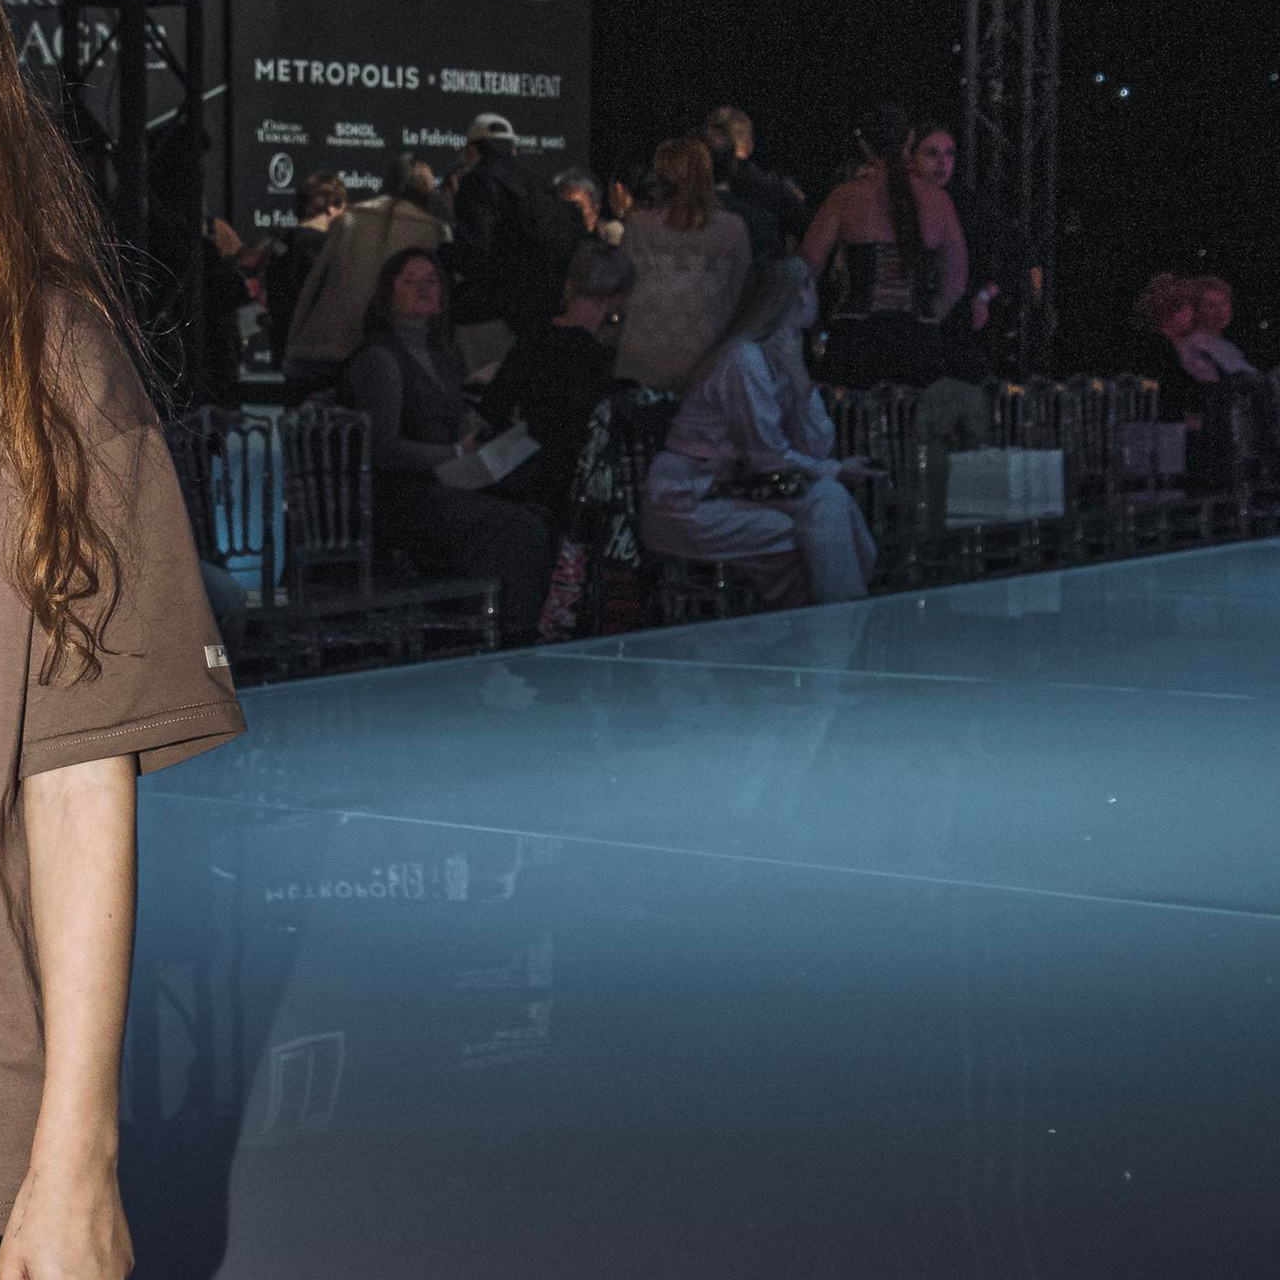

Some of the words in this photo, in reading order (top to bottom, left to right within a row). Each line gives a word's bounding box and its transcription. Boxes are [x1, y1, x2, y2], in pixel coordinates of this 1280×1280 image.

[254, 58, 419, 90] METROPOLIS
[402, 127, 418, 145] La
[420, 129, 467, 148] Fabriqu
[255, 210, 271, 227] La
